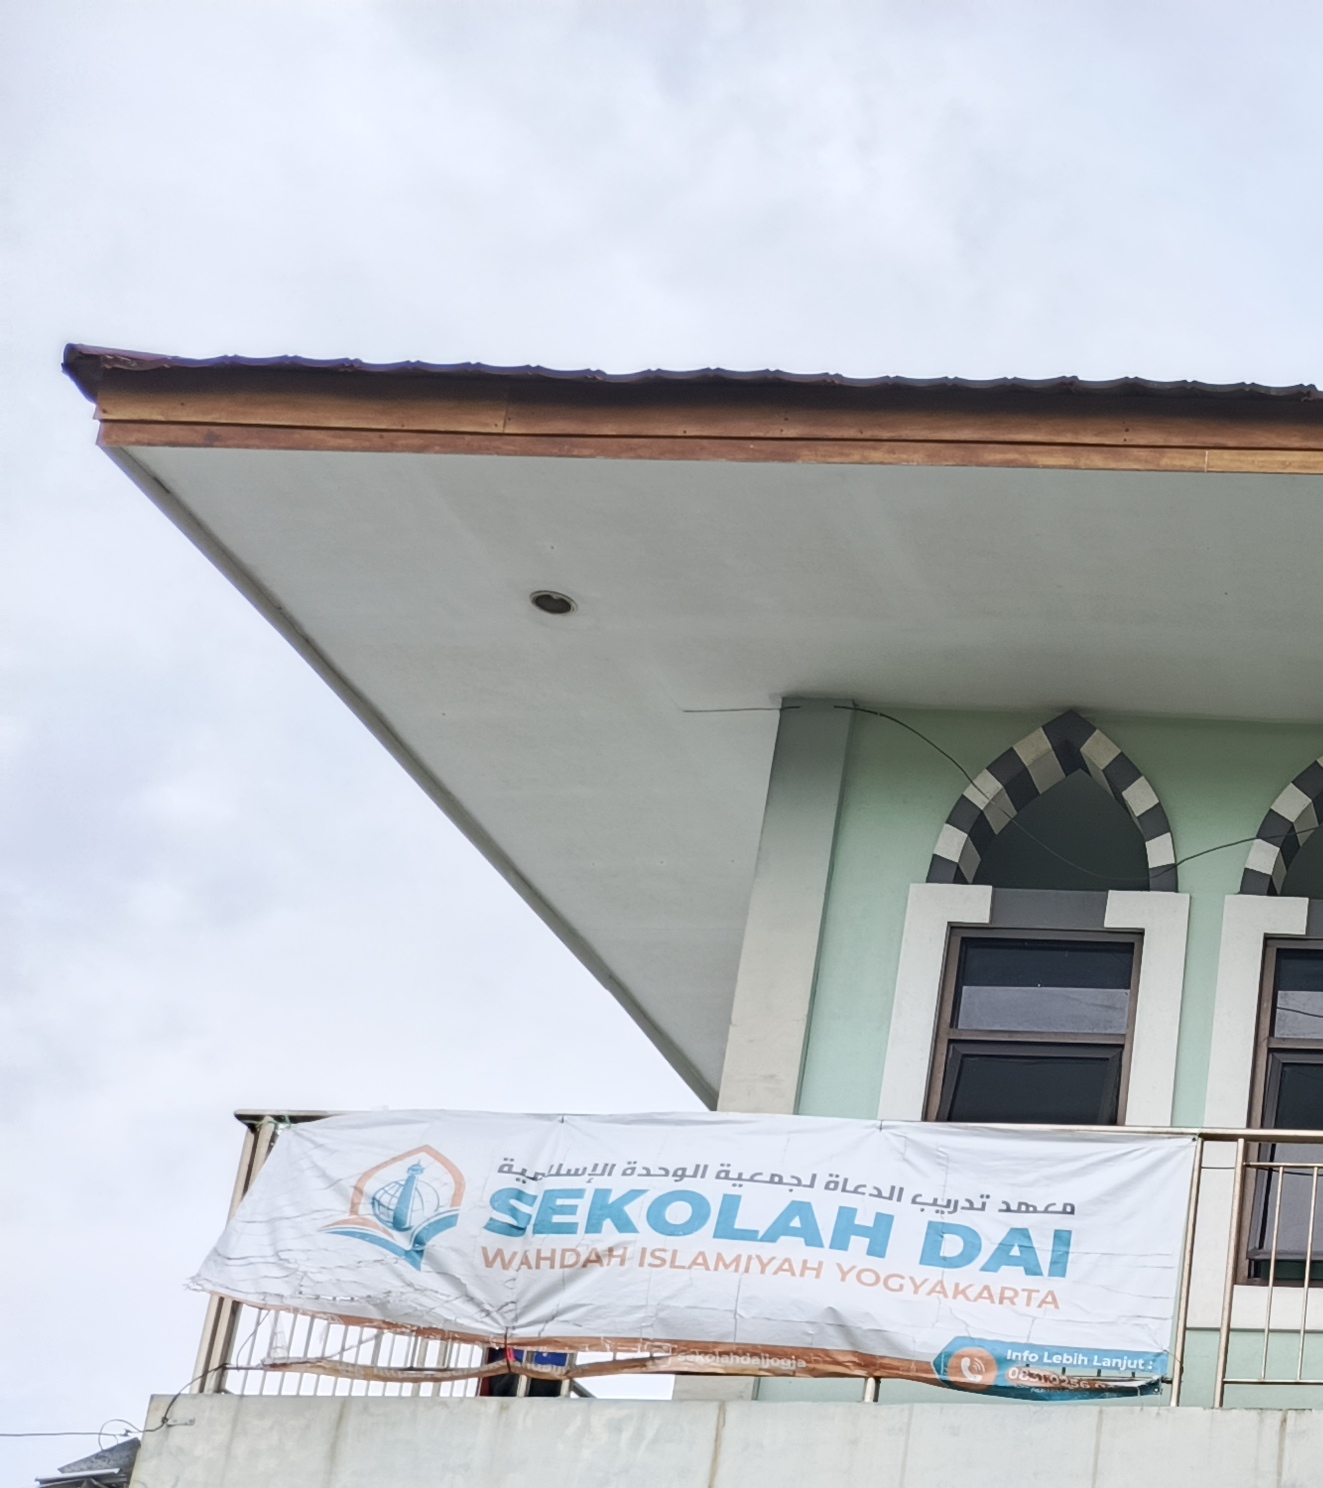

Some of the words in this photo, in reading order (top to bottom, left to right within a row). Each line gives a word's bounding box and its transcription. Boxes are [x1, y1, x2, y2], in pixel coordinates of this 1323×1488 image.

[621, 1161, 709, 1182] الوحدة
[715, 1163, 817, 1193] لجمعية
[824, 1173, 904, 1202] الدعاة
[911, 1193, 991, 1215] تدريب
[998, 1200, 1076, 1215] معهد
[483, 1187, 895, 1259] SEKOLAH
[919, 1220, 1073, 1278] DAI
[481, 1246, 628, 1271] WAHDAH
[638, 1247, 824, 1279] ISLAMIYAH
[835, 1262, 1060, 1310] YOGYAKARTA
[1006, 1349, 1039, 1363] Info
[1043, 1351, 1088, 1366] Lebih
[1093, 1355, 1145, 1371] Lanjut
